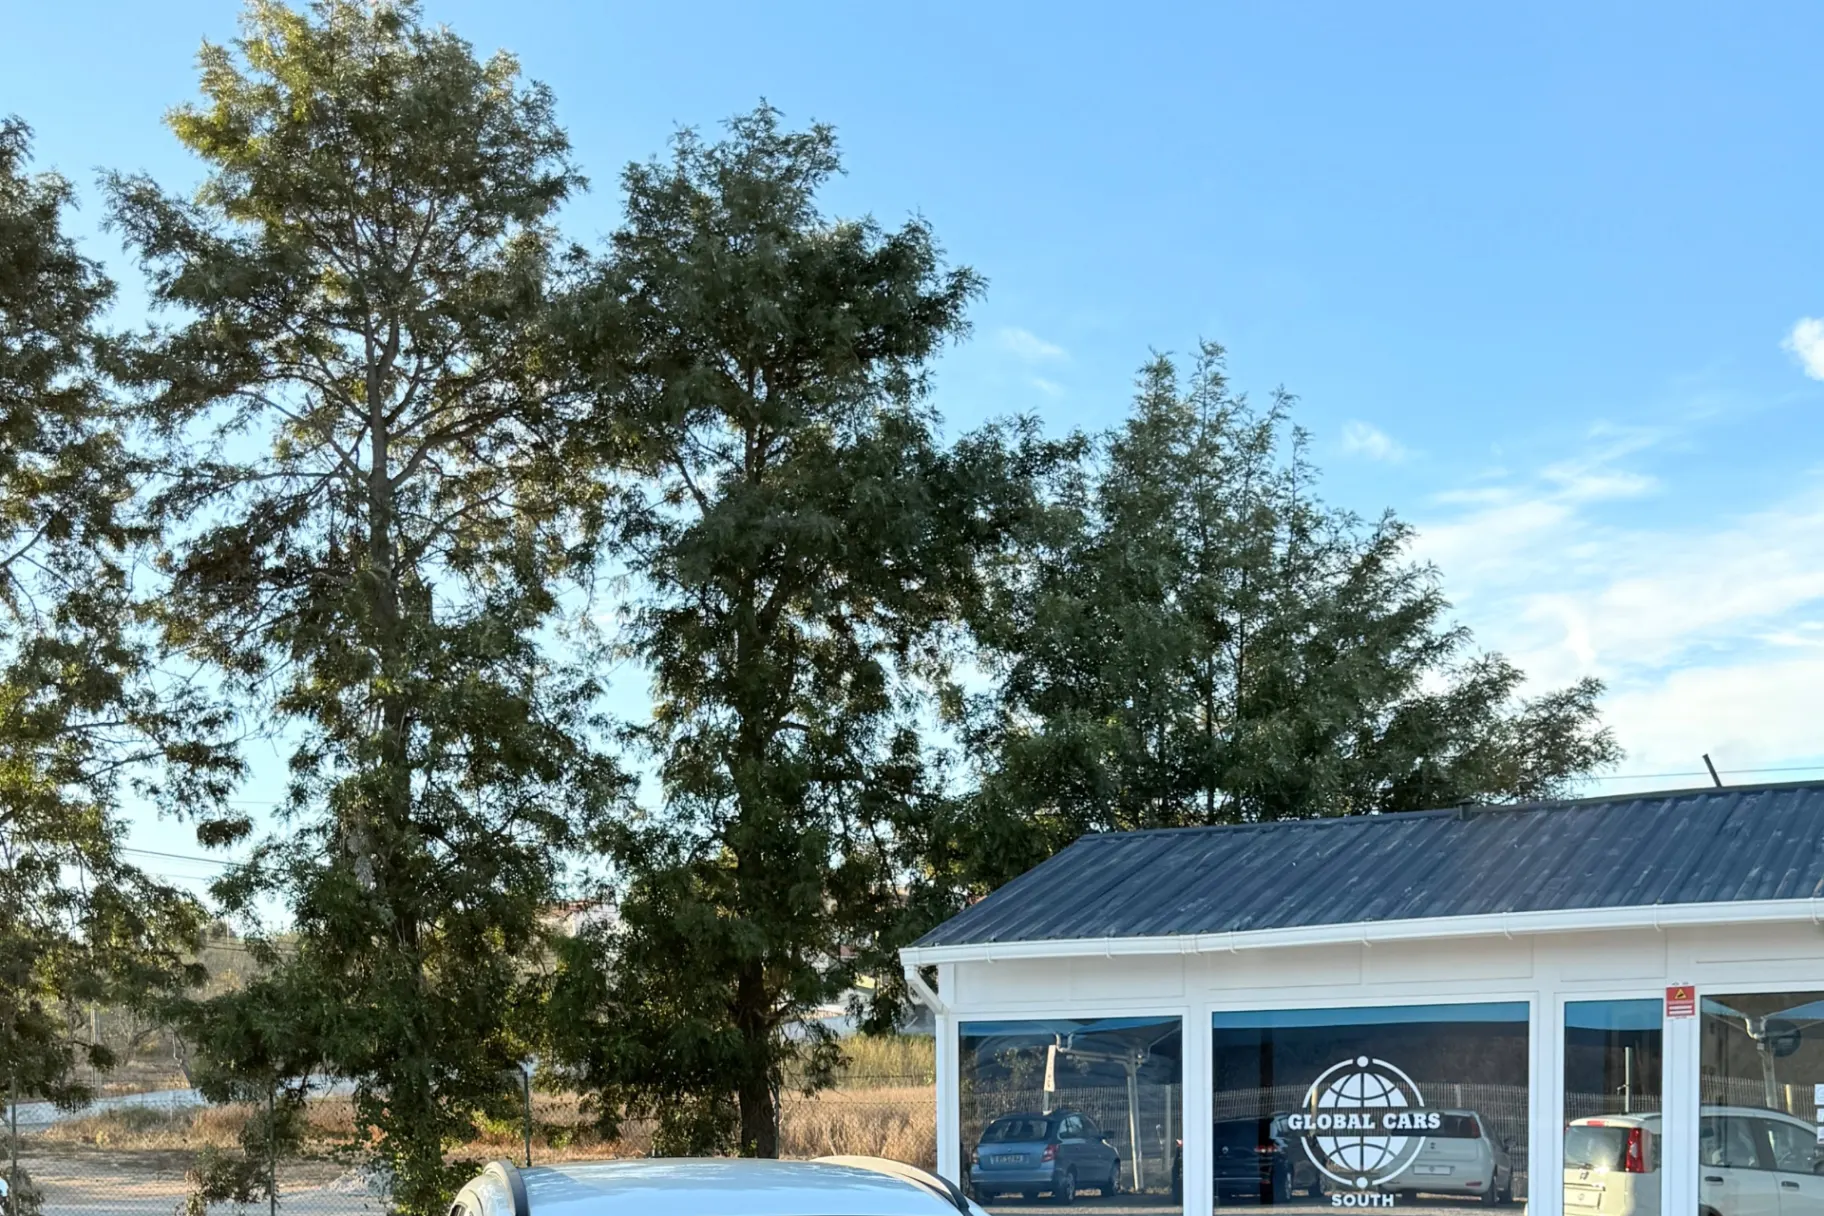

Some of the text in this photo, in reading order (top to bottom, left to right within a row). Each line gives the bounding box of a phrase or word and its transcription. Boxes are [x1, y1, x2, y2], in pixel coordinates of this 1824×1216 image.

[1287, 1112, 1441, 1130] GLOBAL CARS
[1331, 1193, 1394, 1207] SOUTH
